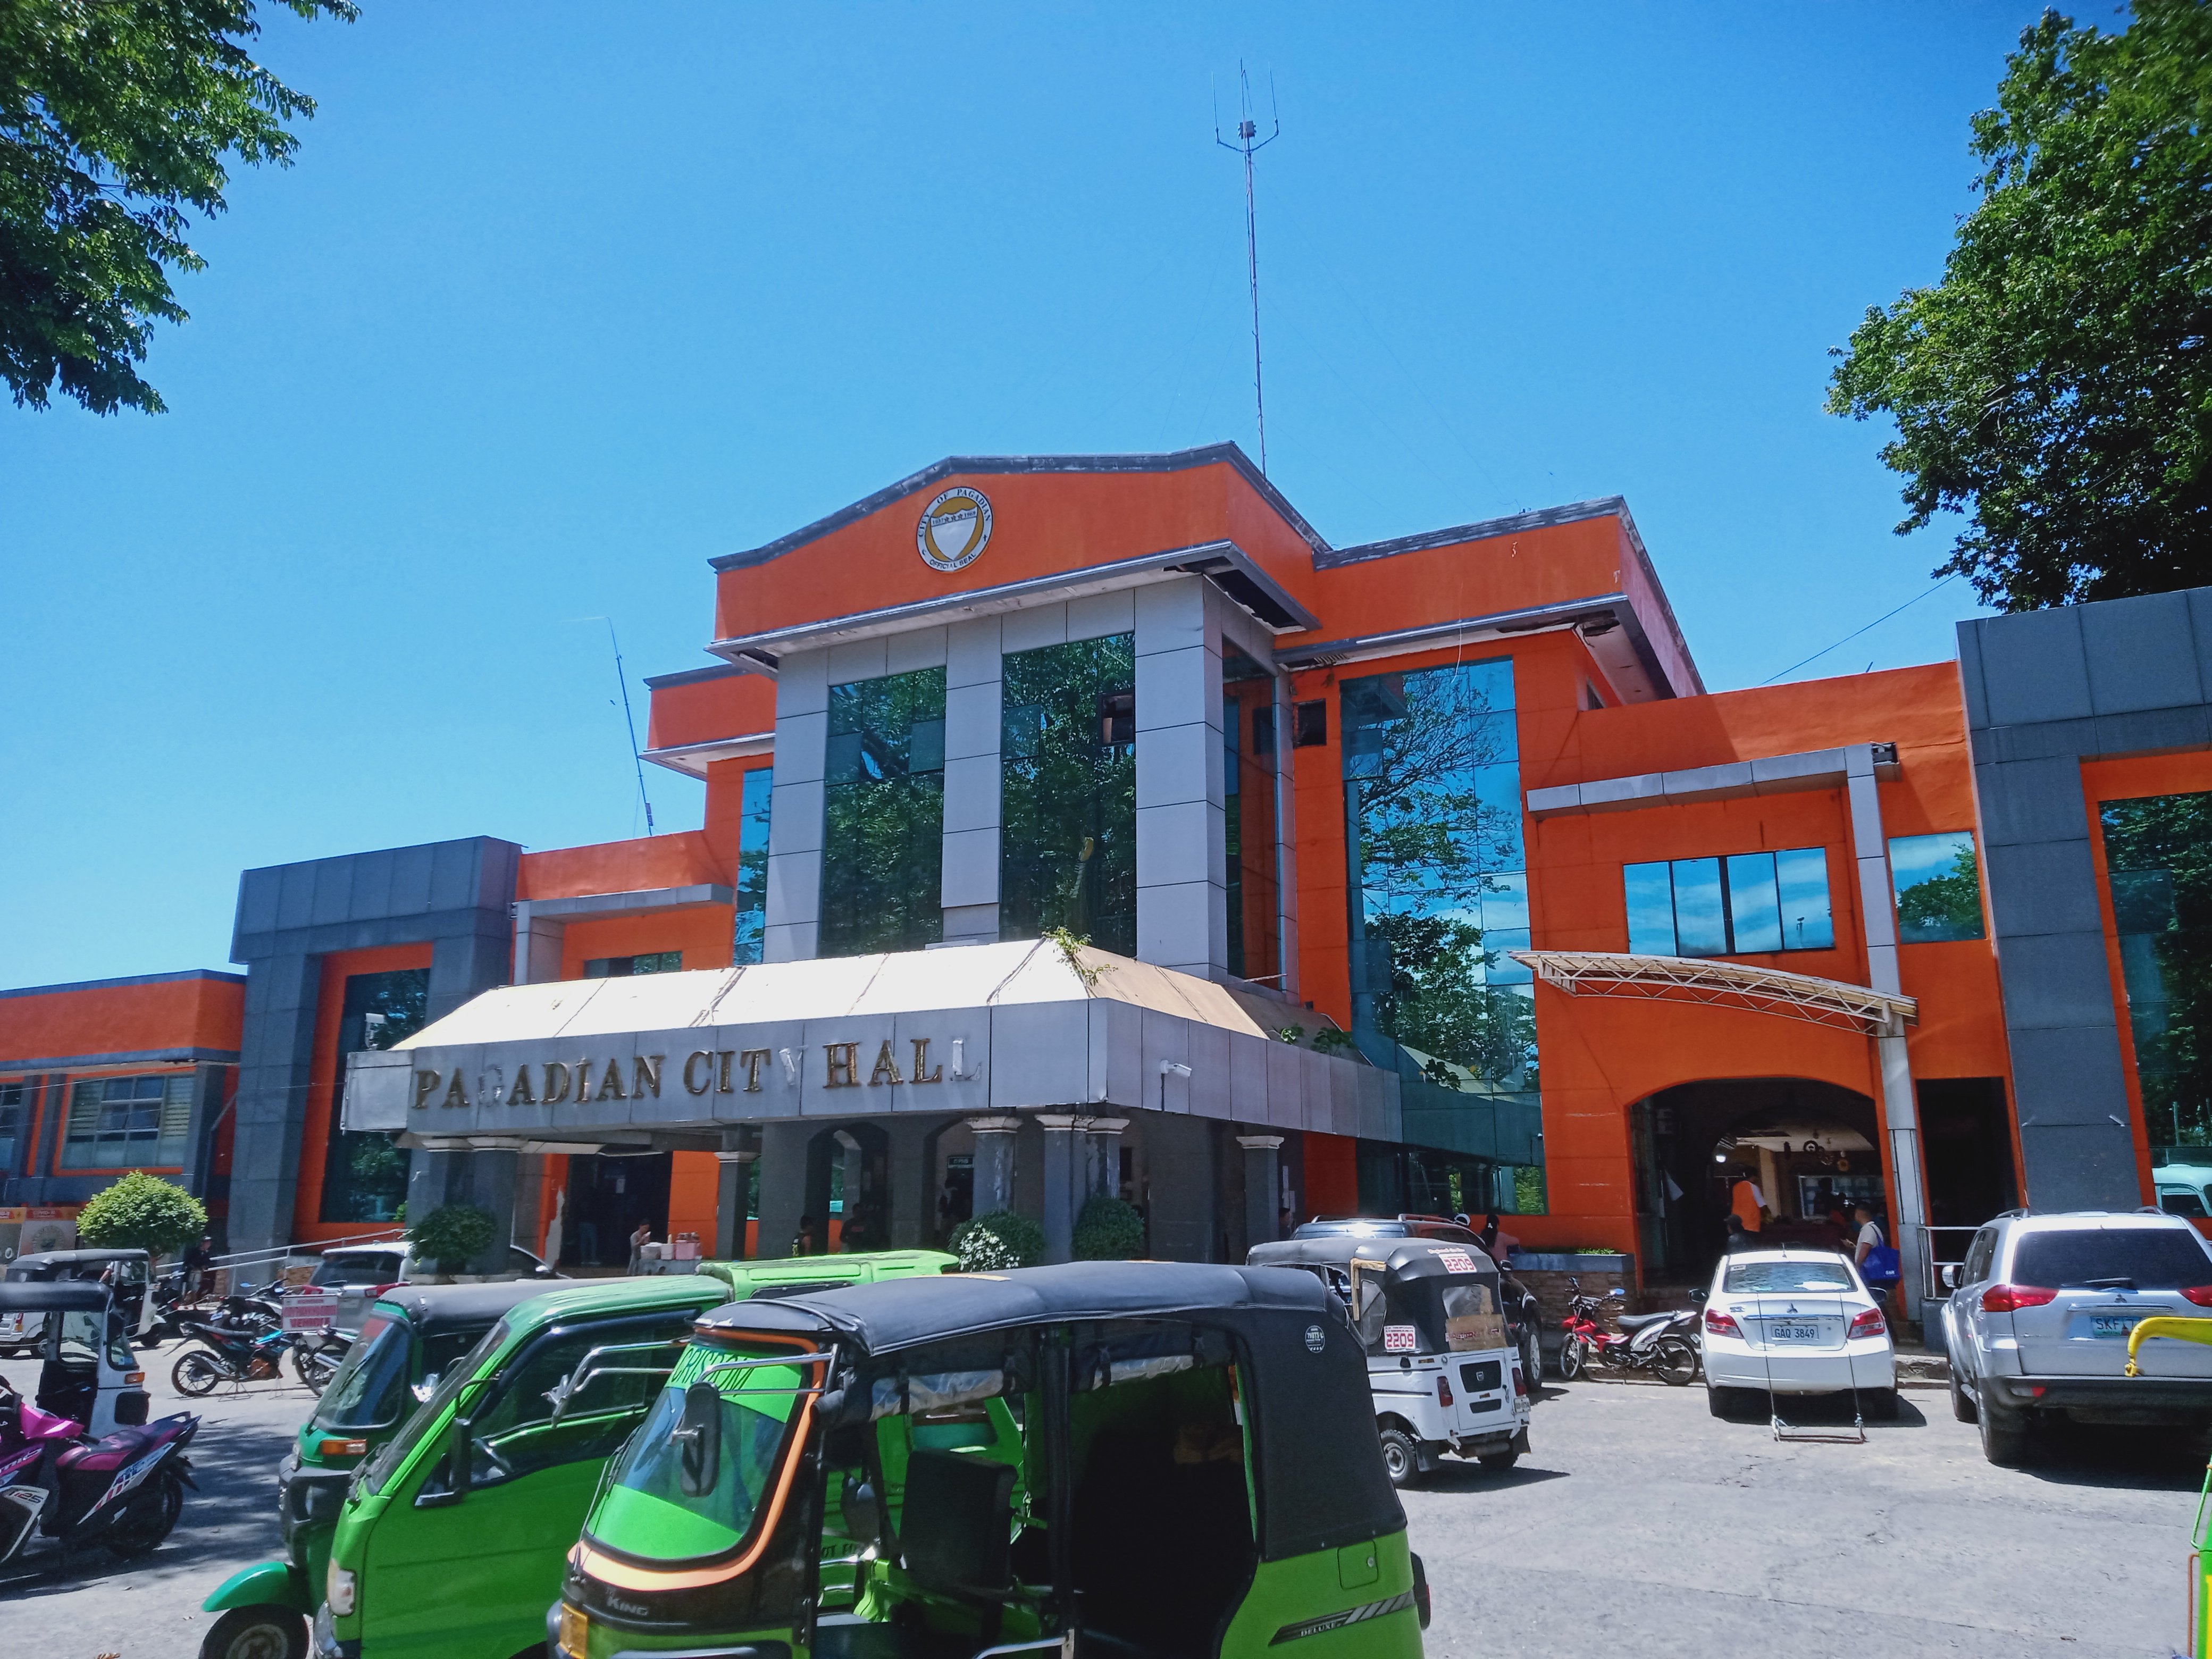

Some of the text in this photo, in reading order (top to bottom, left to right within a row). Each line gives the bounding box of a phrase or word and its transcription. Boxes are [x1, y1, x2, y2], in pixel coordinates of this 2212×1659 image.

[918, 489, 991, 537] CITY OF PAGADIAN
[929, 553, 976, 569] OFFICIAL SEAL
[412, 1054, 666, 1110] PAGADIAN
[823, 1037, 982, 1088] HALL
[1443, 1259, 1474, 1271] 2209
[2096, 1318, 2119, 1330] SKF
[1386, 1333, 1414, 1347] 2209
[1774, 1328, 1815, 1338] GAQ 3849
[607, 1596, 649, 1616] KING
[1301, 1622, 1336, 1637] DELUXE
